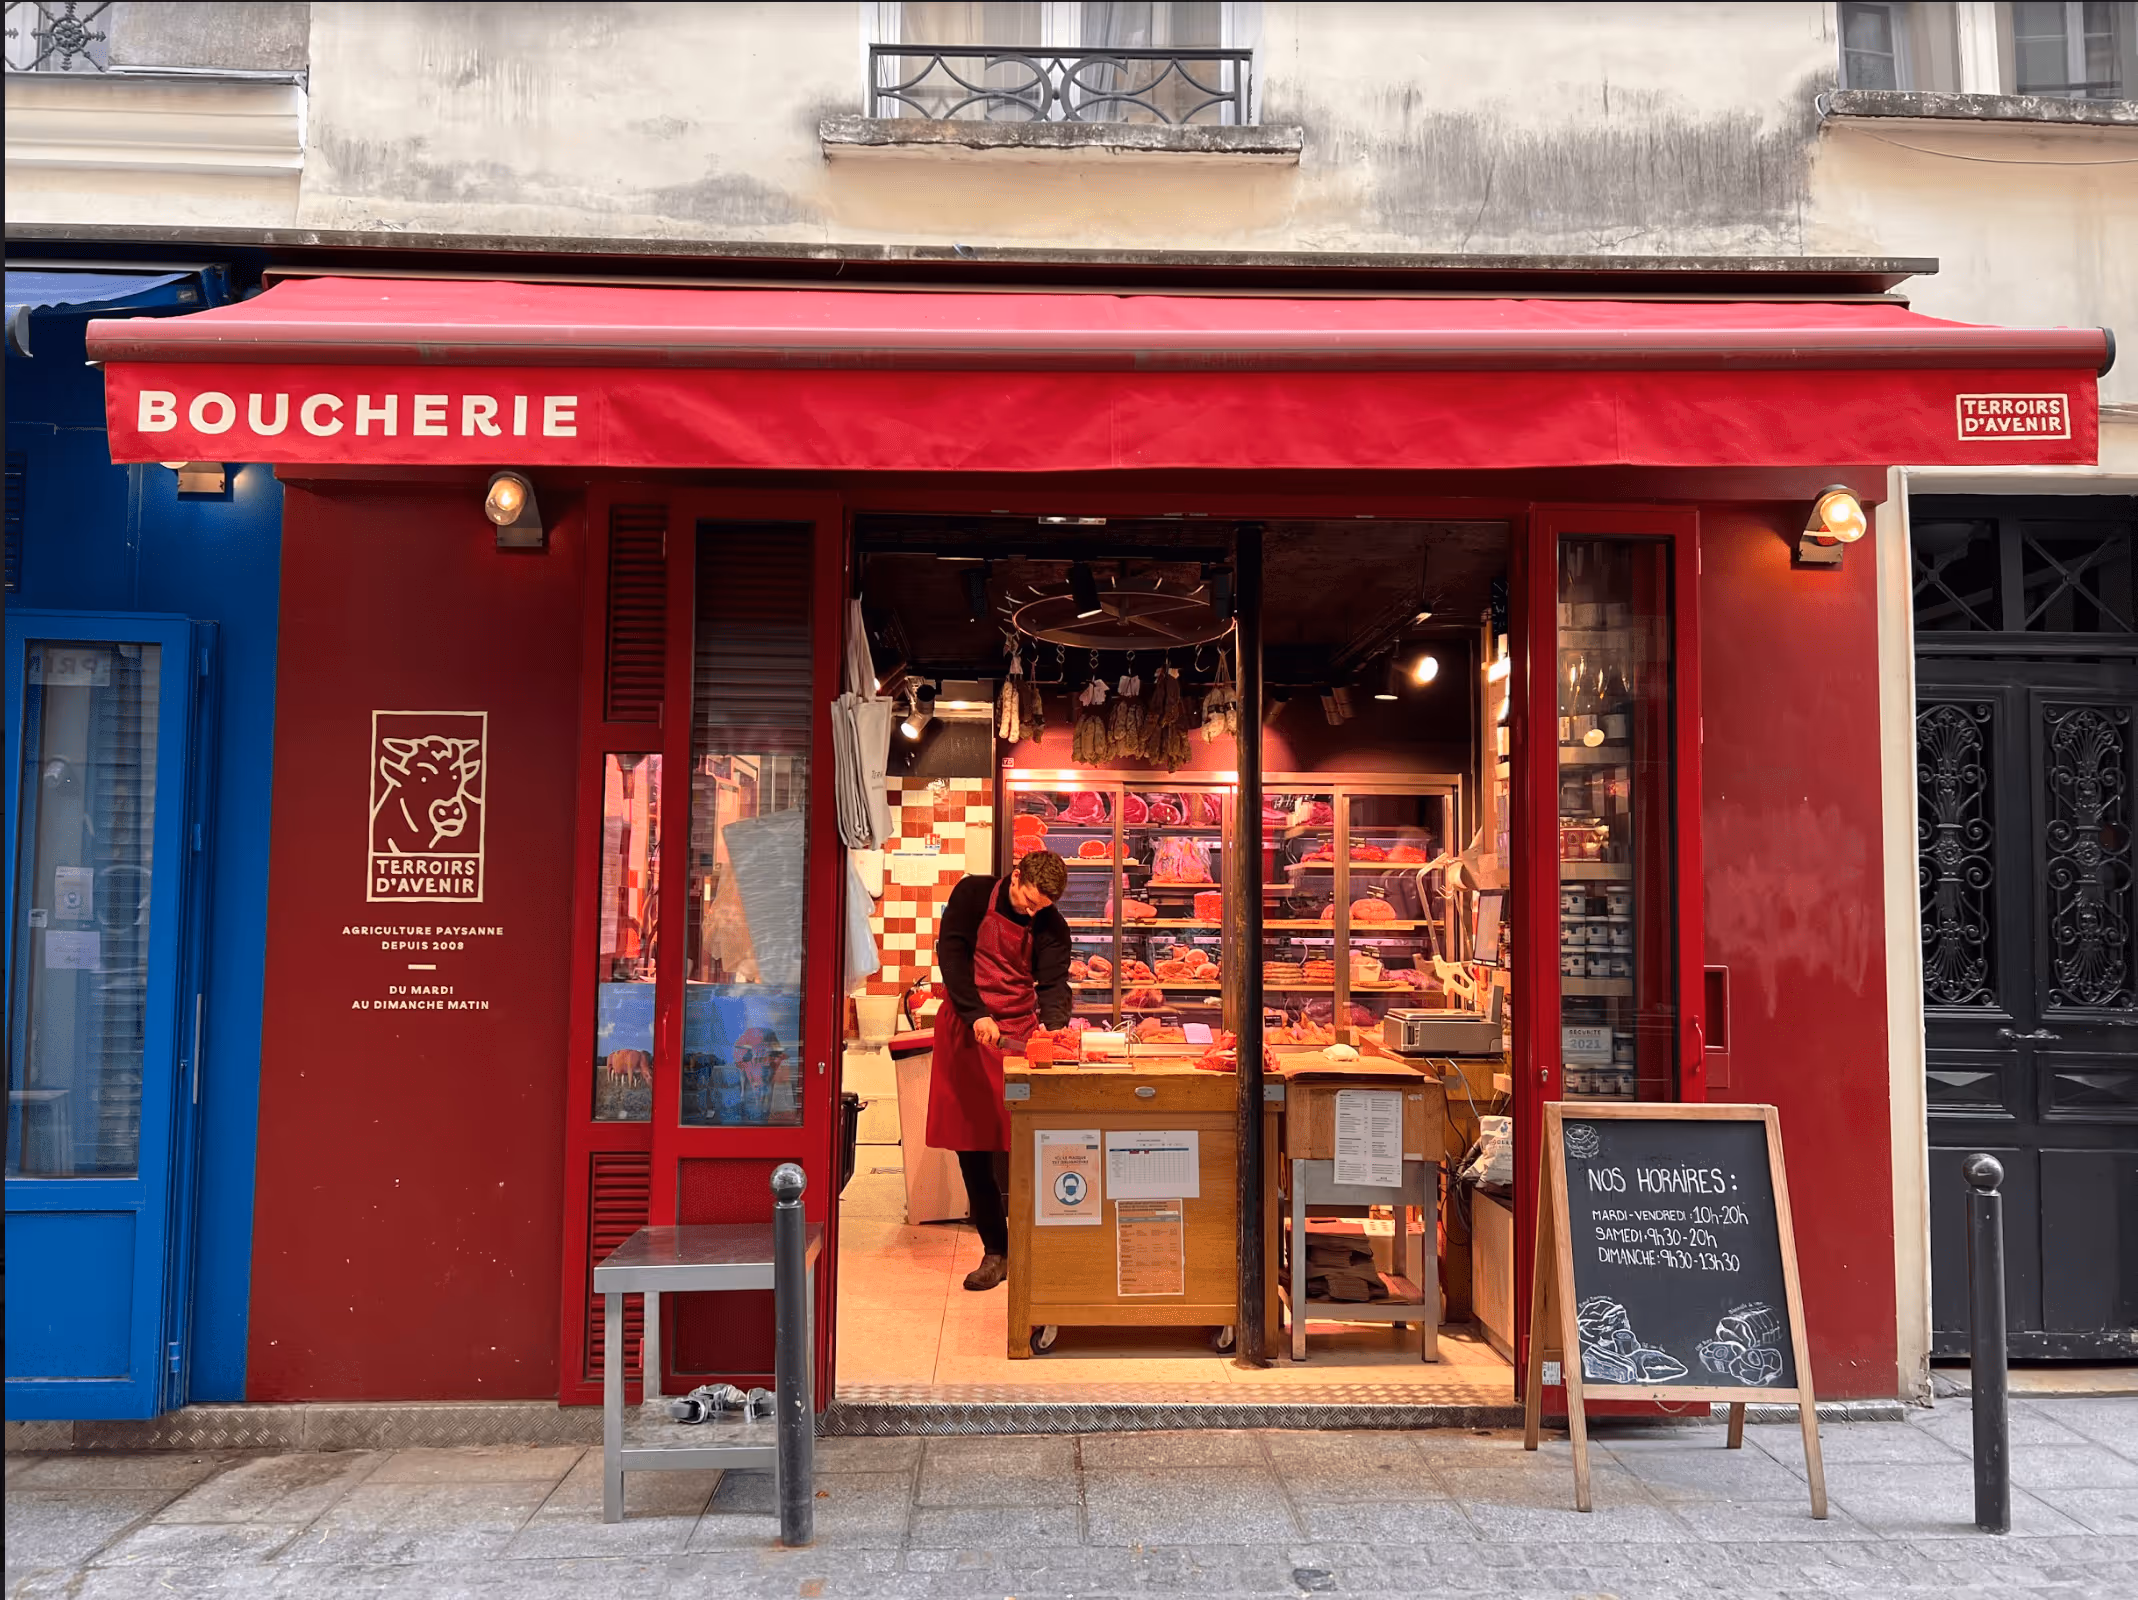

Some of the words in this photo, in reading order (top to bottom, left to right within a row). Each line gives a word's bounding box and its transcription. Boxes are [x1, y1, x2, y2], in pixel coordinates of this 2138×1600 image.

[137, 390, 578, 437] BOUCHERIE
[1963, 399, 2061, 415] TERROIRS
[1964, 416, 2062, 432] D'AVENIR
[376, 859, 476, 875] TERROIRS
[376, 877, 475, 894] D'AVENIR
[342, 926, 432, 936] AGRICULTURE
[435, 926, 504, 936] PAYSANNE
[381, 940, 429, 951] DEPUIS
[432, 941, 465, 951] 2008
[389, 985, 407, 995] DU
[410, 985, 454, 995] MARDI
[351, 1000, 370, 1010] AU
[373, 1000, 444, 1010] DIMANCHE
[447, 1000, 489, 1010] MATIN
[1569, 1039, 1601, 1049] 2021
[1587, 1166, 1627, 1193] NOS
